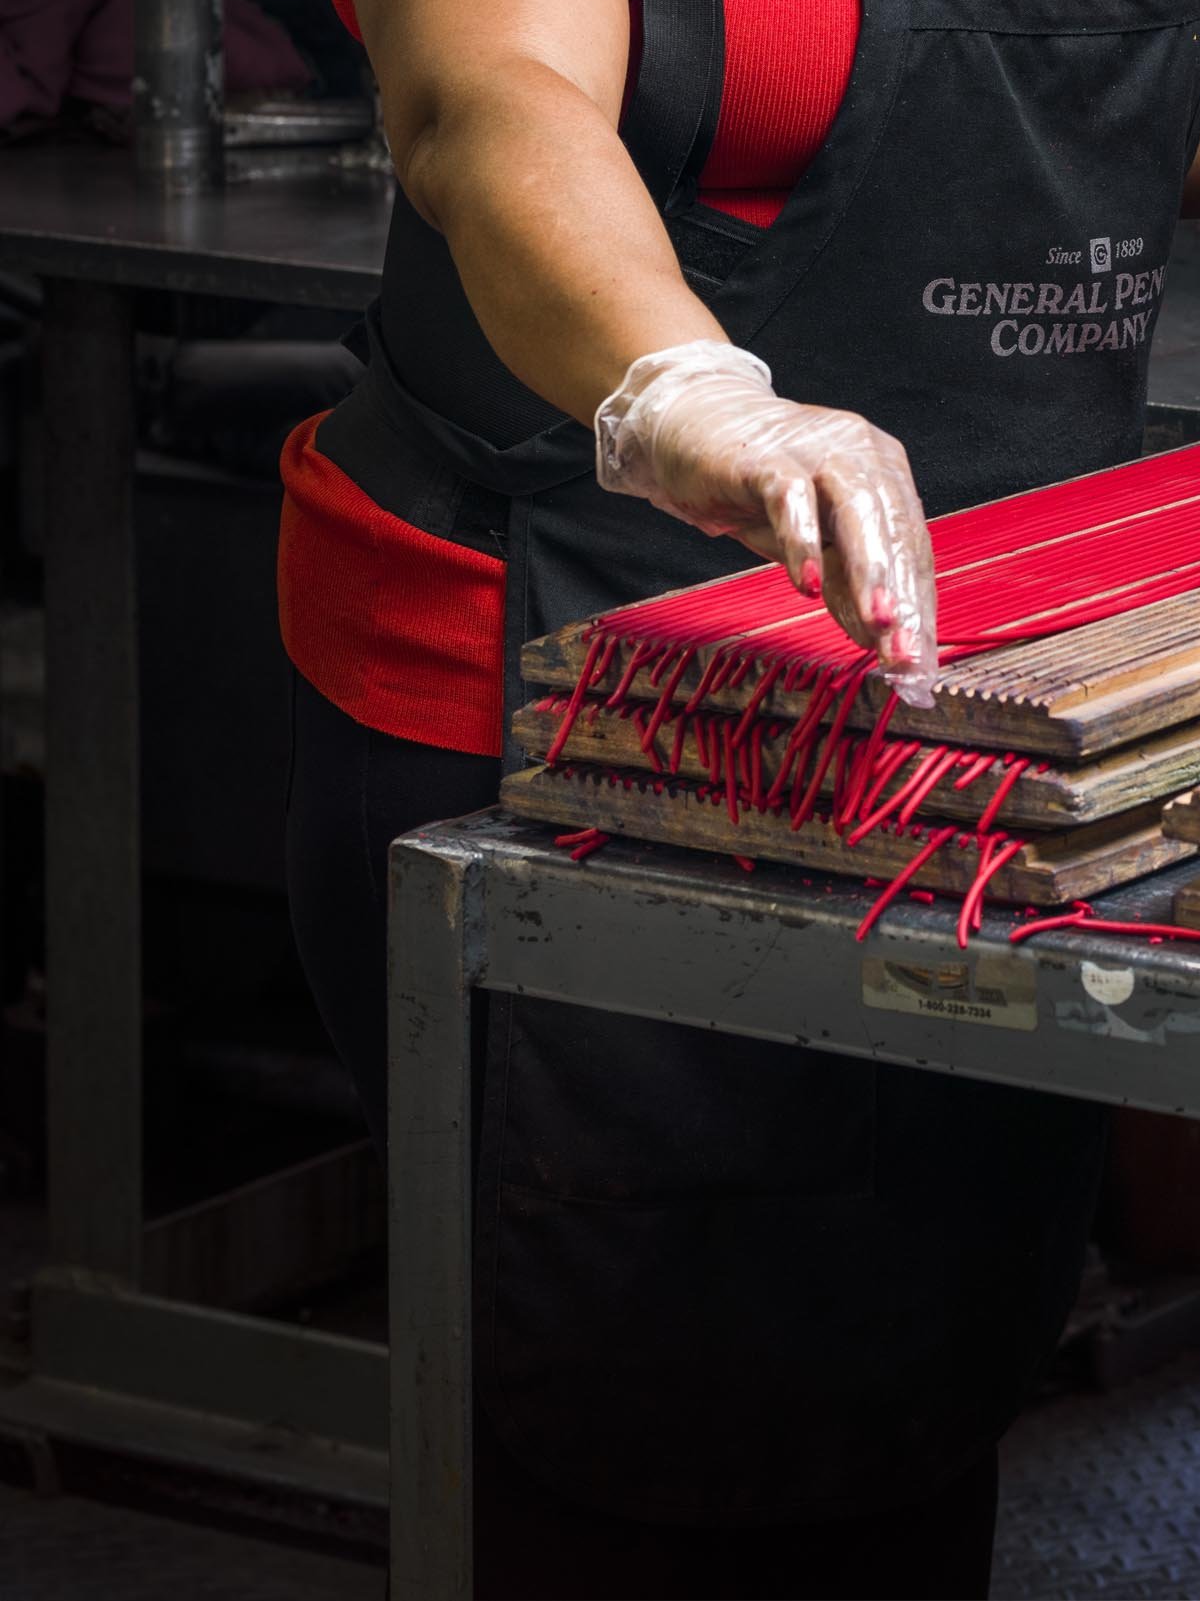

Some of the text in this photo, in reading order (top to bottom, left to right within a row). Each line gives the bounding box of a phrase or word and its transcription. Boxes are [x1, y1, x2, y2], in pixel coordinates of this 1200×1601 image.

[1045, 246, 1083, 265] Since
[1115, 237, 1144, 259] 1889
[921, 265, 1167, 316] GENERAL PEN
[990, 311, 1151, 356] COMPANY
